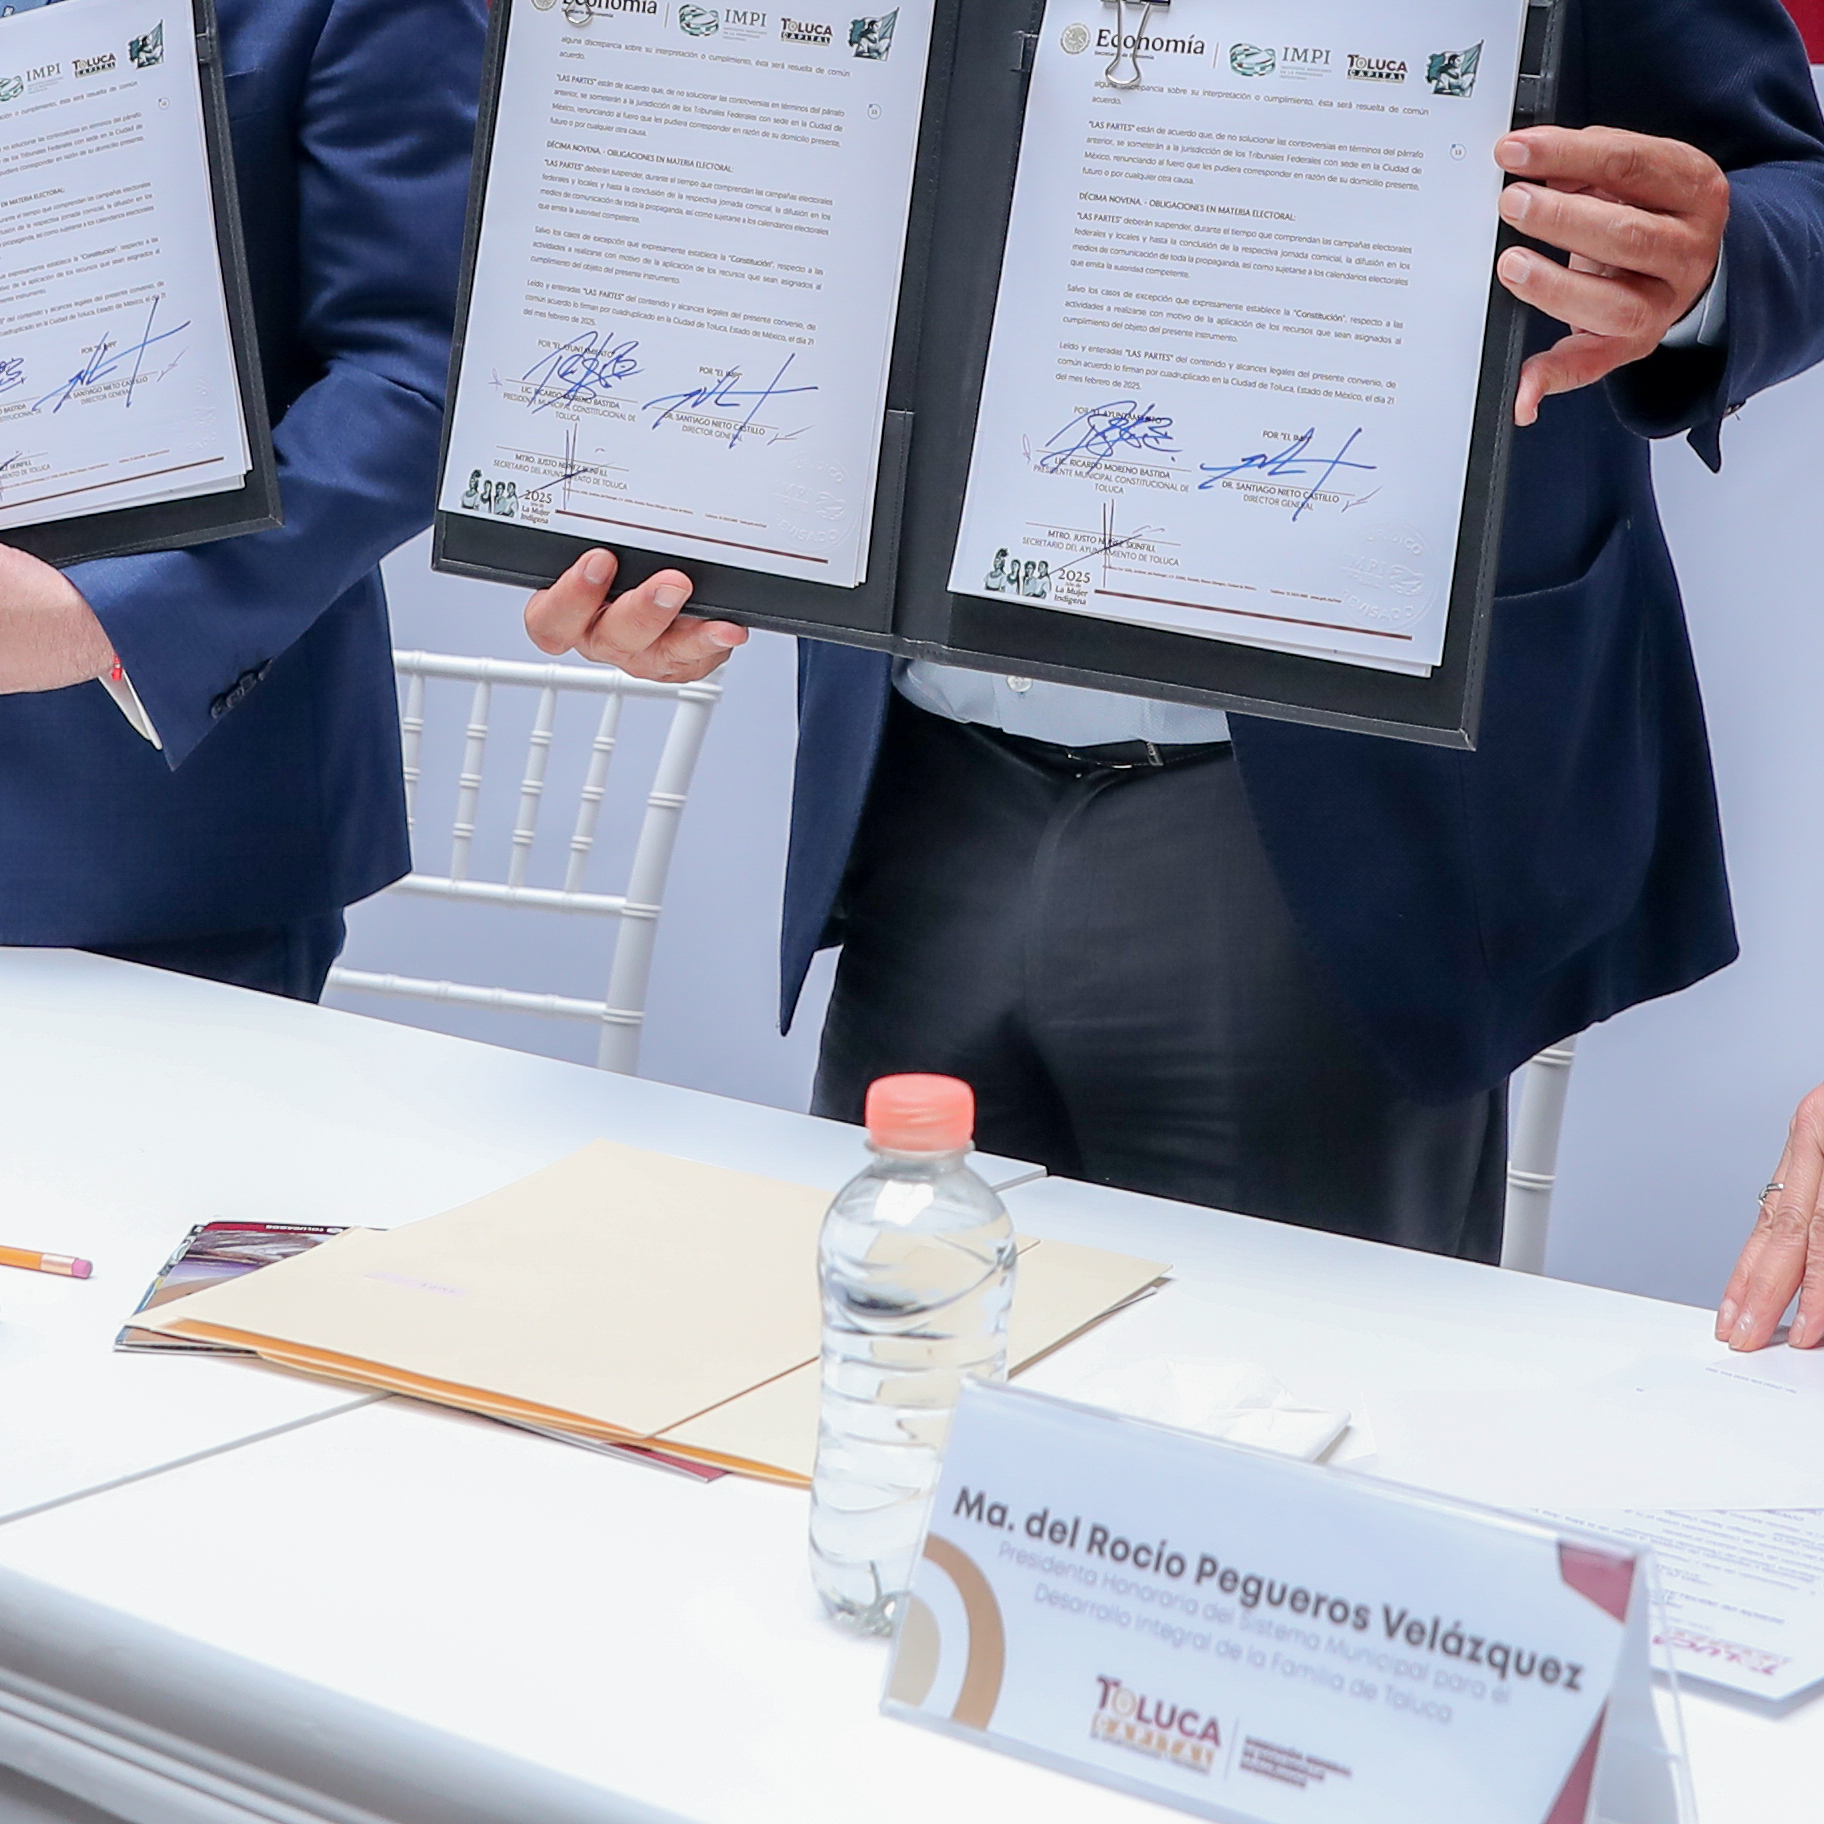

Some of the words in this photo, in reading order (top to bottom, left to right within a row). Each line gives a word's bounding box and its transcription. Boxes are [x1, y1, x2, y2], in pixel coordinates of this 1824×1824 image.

[724, 8, 768, 28] IMPI
[780, 17, 833, 37] TOLUCA
[1096, 28, 1205, 56] Economía
[1281, 46, 1332, 65] IMPI
[1346, 53, 1409, 73] TOLUCA
[26, 62, 62, 83] IMPI
[72, 52, 117, 71] TOLUCA
[524, 489, 553, 504] 2025
[1057, 567, 1091, 584] 2025
[953, 1487, 1015, 1532] Ma.
[1024, 1507, 1082, 1552] del
[1085, 1521, 1186, 1581] Rocío
[1194, 1555, 1371, 1633] Pegueros
[1380, 1606, 1587, 1694] Velázquez
[1097, 1673, 1222, 1748] TOLUCA
